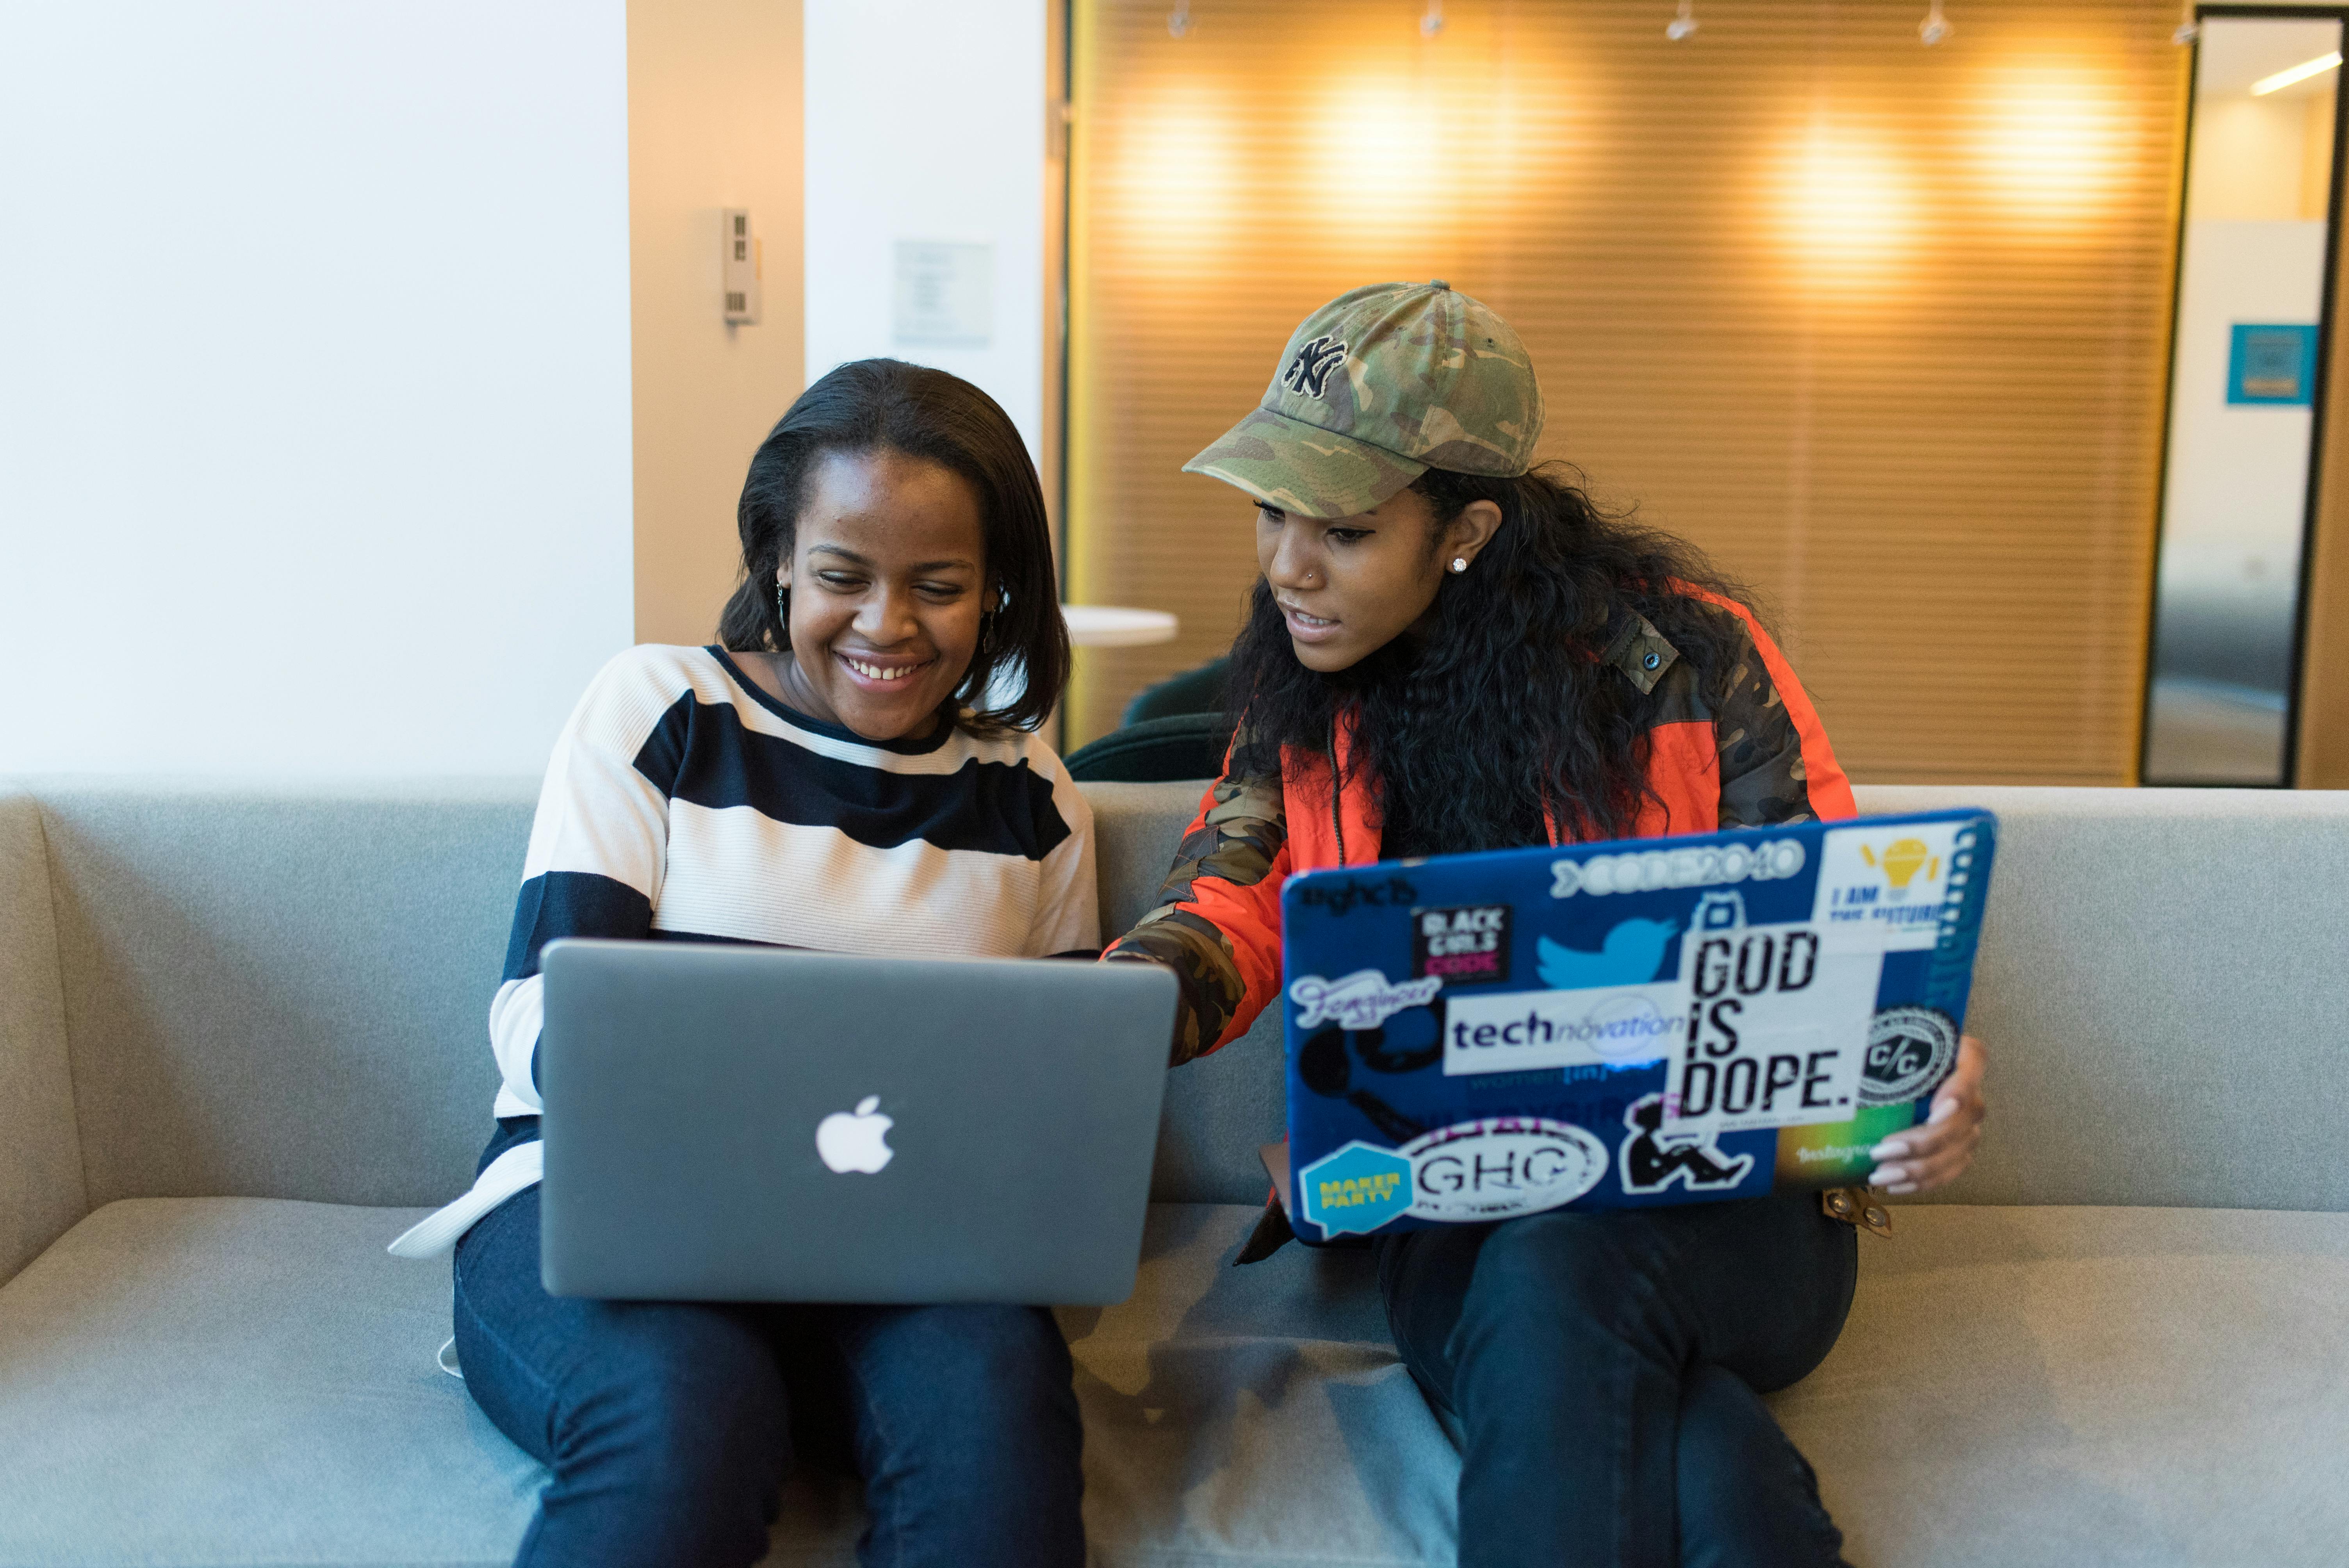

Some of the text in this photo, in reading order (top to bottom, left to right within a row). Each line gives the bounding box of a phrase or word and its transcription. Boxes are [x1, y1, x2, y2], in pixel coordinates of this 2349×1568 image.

[1845, 884, 1879, 904] AM
[1422, 908, 1504, 936] BLACK
[1428, 931, 1497, 957] GIRLS
[1693, 930, 1820, 999] GOD
[1454, 1010, 1686, 1050] technovation
[1684, 999, 1743, 1060] IS
[1679, 1049, 1849, 1119] DOPE.
[1797, 1143, 1871, 1164] Instagra
[1320, 1172, 1400, 1193] MAKER
[1417, 1147, 1567, 1195] GHC
[1321, 1188, 1394, 1210] PARTY
